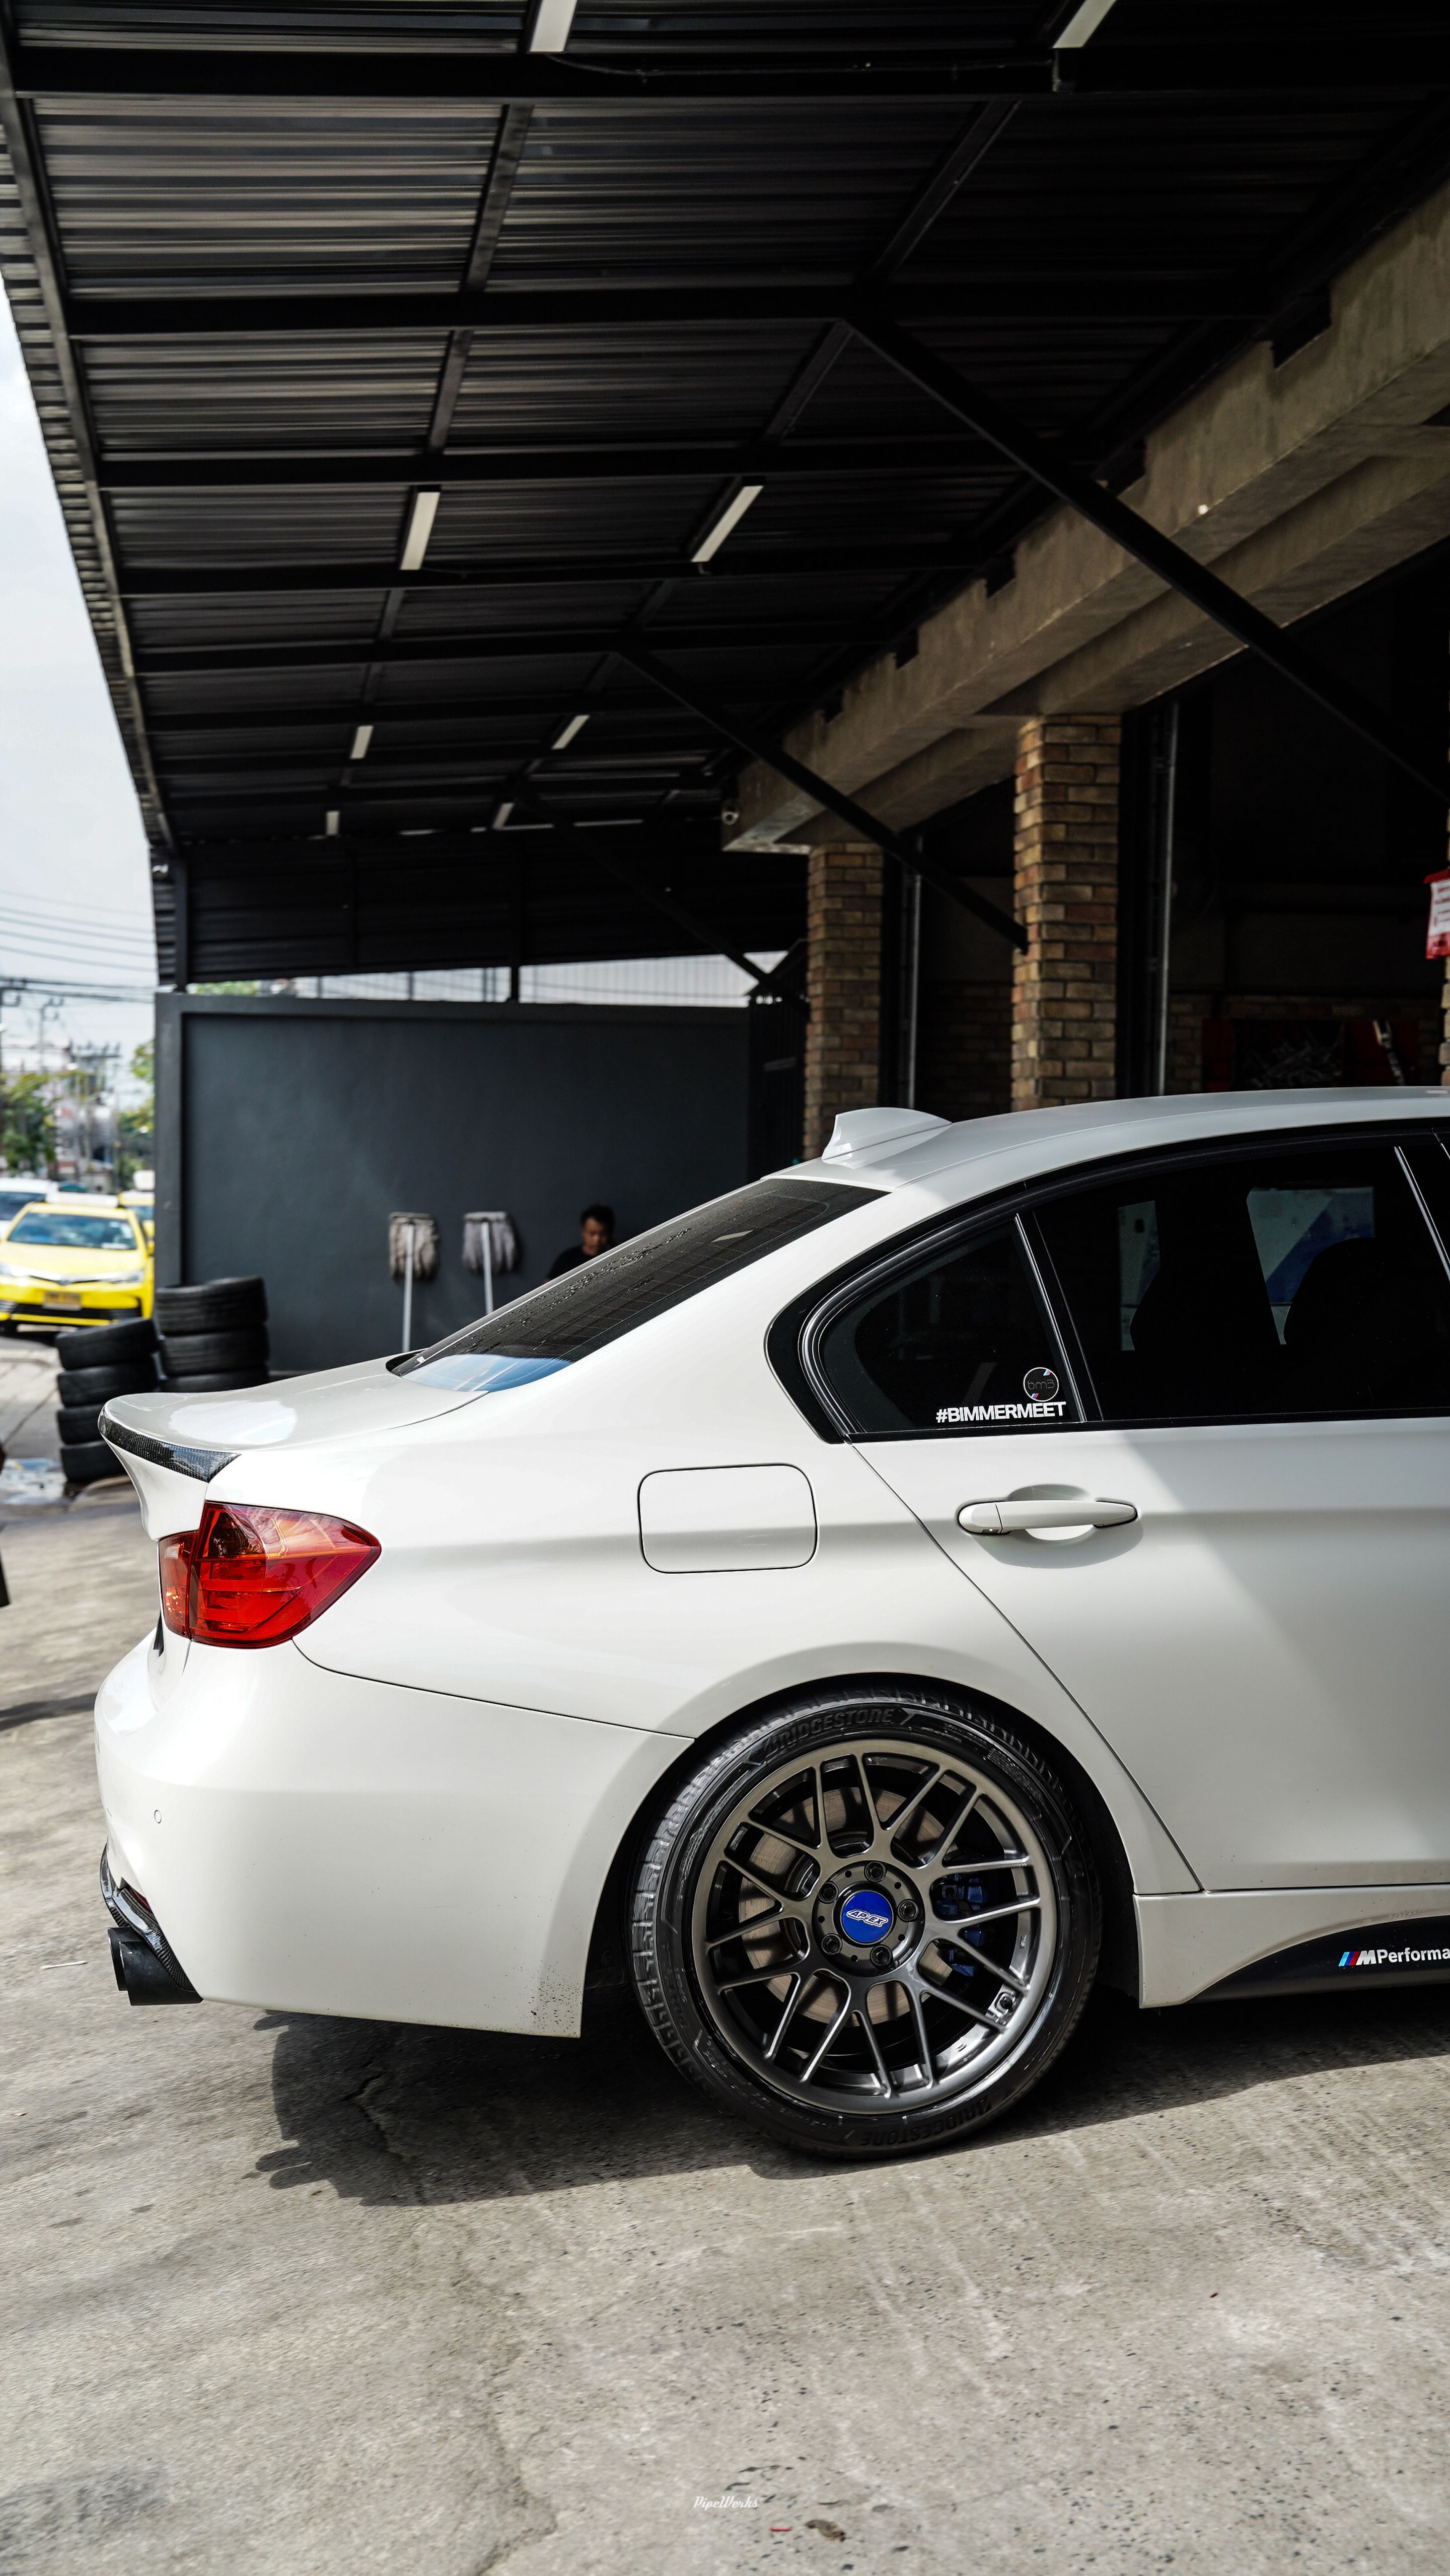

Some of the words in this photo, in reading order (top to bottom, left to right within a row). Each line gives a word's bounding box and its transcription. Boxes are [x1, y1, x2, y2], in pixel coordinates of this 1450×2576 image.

[1028, 1379, 1055, 1390] bm3
[935, 1402, 1066, 1423] #BIMMERMEET
[762, 1708, 895, 1759] BRIDGESTONE
[846, 1909, 889, 1928] APEX
